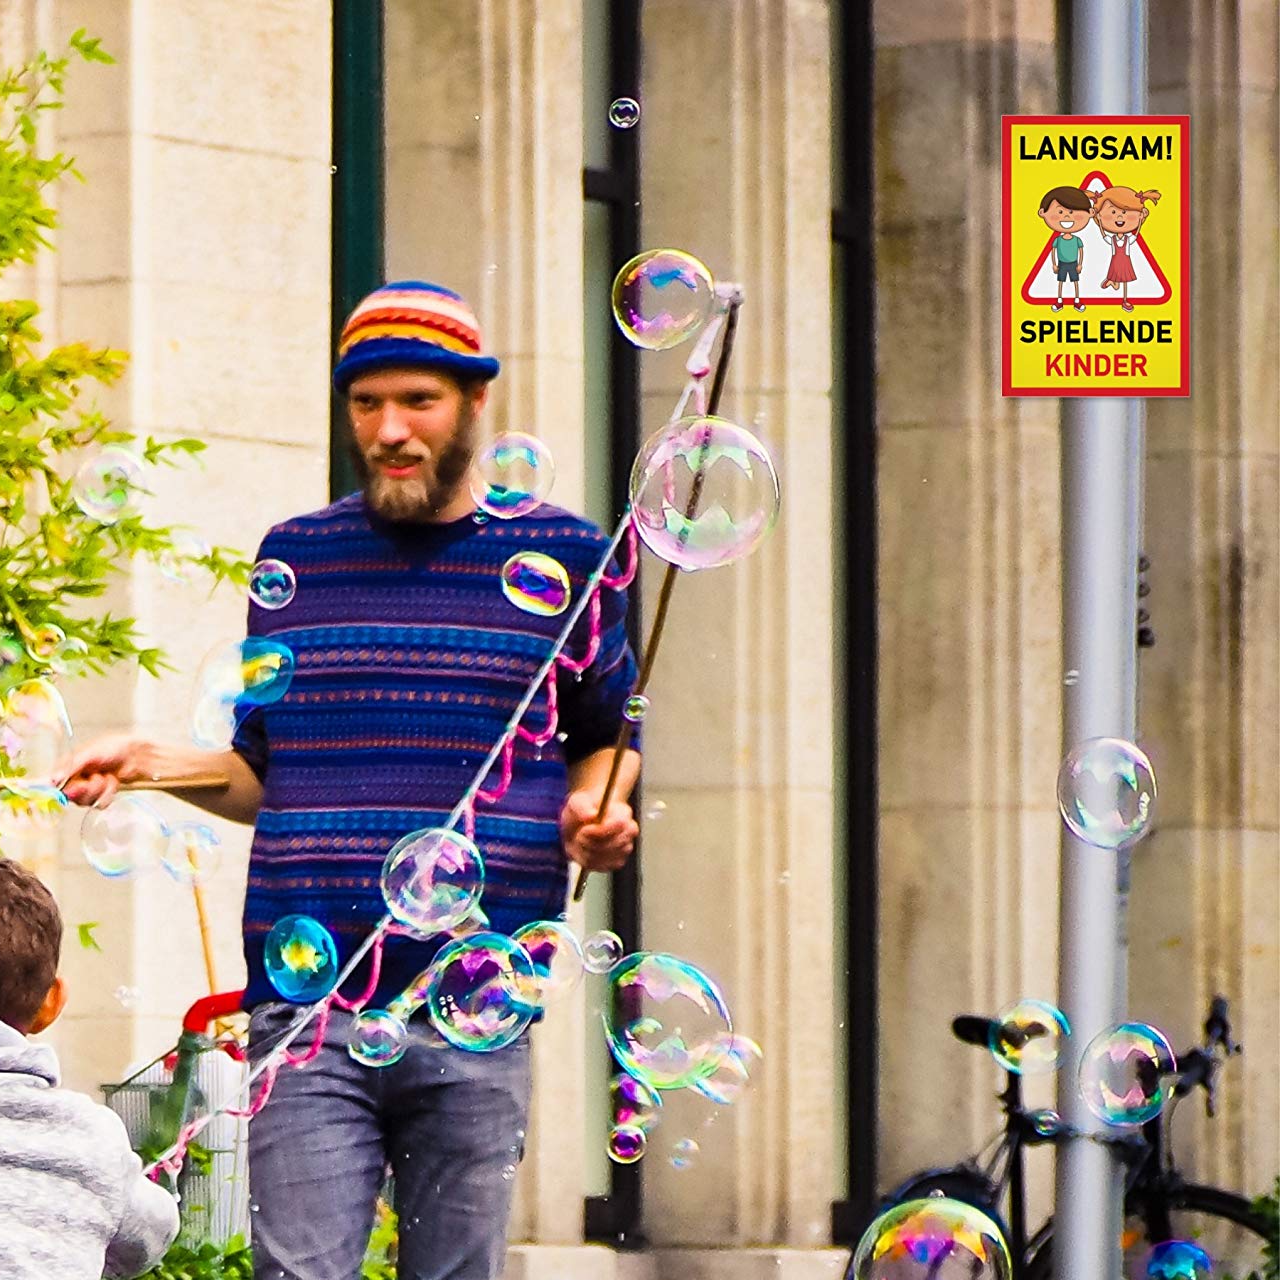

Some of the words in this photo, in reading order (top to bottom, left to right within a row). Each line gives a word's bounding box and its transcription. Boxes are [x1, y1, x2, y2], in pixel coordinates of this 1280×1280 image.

[1020, 136, 1172, 160] LANGSAM!
[1020, 320, 1172, 343] SPIELENDE
[1045, 354, 1148, 376] KINDER
